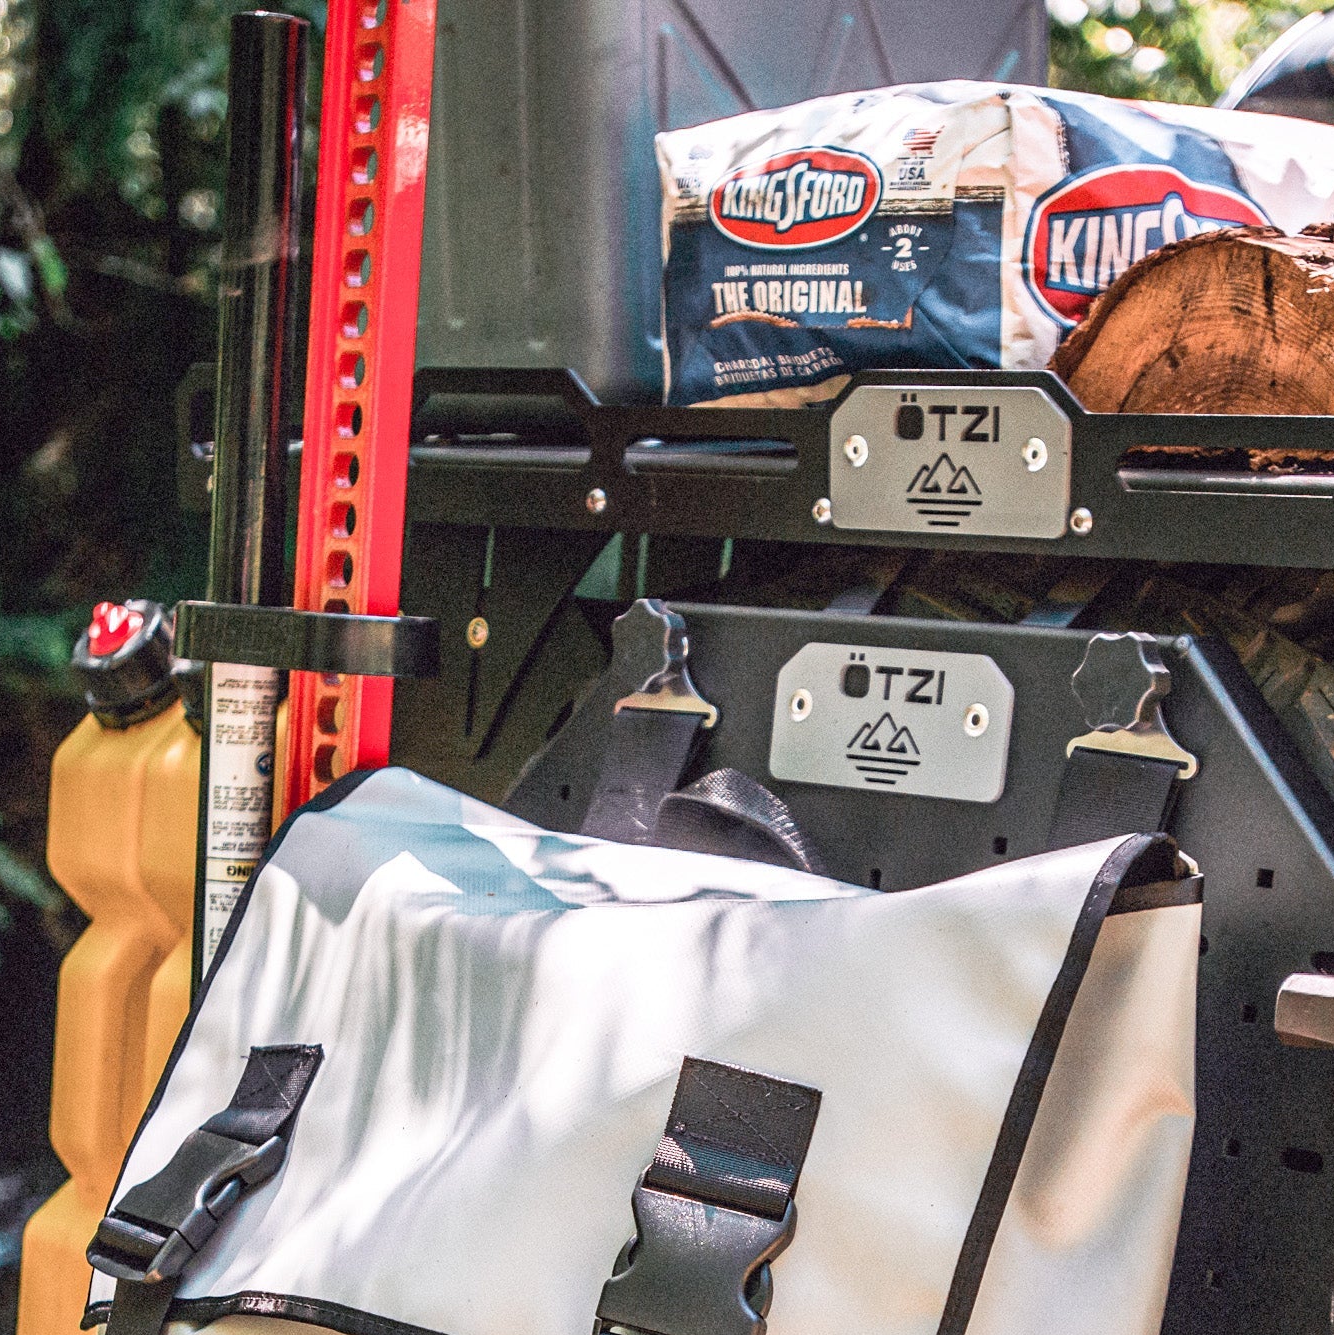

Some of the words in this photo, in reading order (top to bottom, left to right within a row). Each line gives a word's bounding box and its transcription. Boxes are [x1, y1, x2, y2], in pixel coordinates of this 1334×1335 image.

[899, 167, 926, 180] USA
[721, 162, 866, 232] KINGSFORD
[888, 224, 923, 237] ABOUT
[895, 237, 912, 258] 2
[750, 264, 788, 276] NATURAL
[788, 263, 850, 276] INGREDIENTS
[891, 260, 918, 272] USES
[711, 281, 750, 313] THE
[752, 280, 867, 313] ORIGINAL
[713, 356, 776, 374] CHARCOAL
[894, 393, 1001, 443] ÖTZI
[840, 653, 946, 706] ÖTZI
